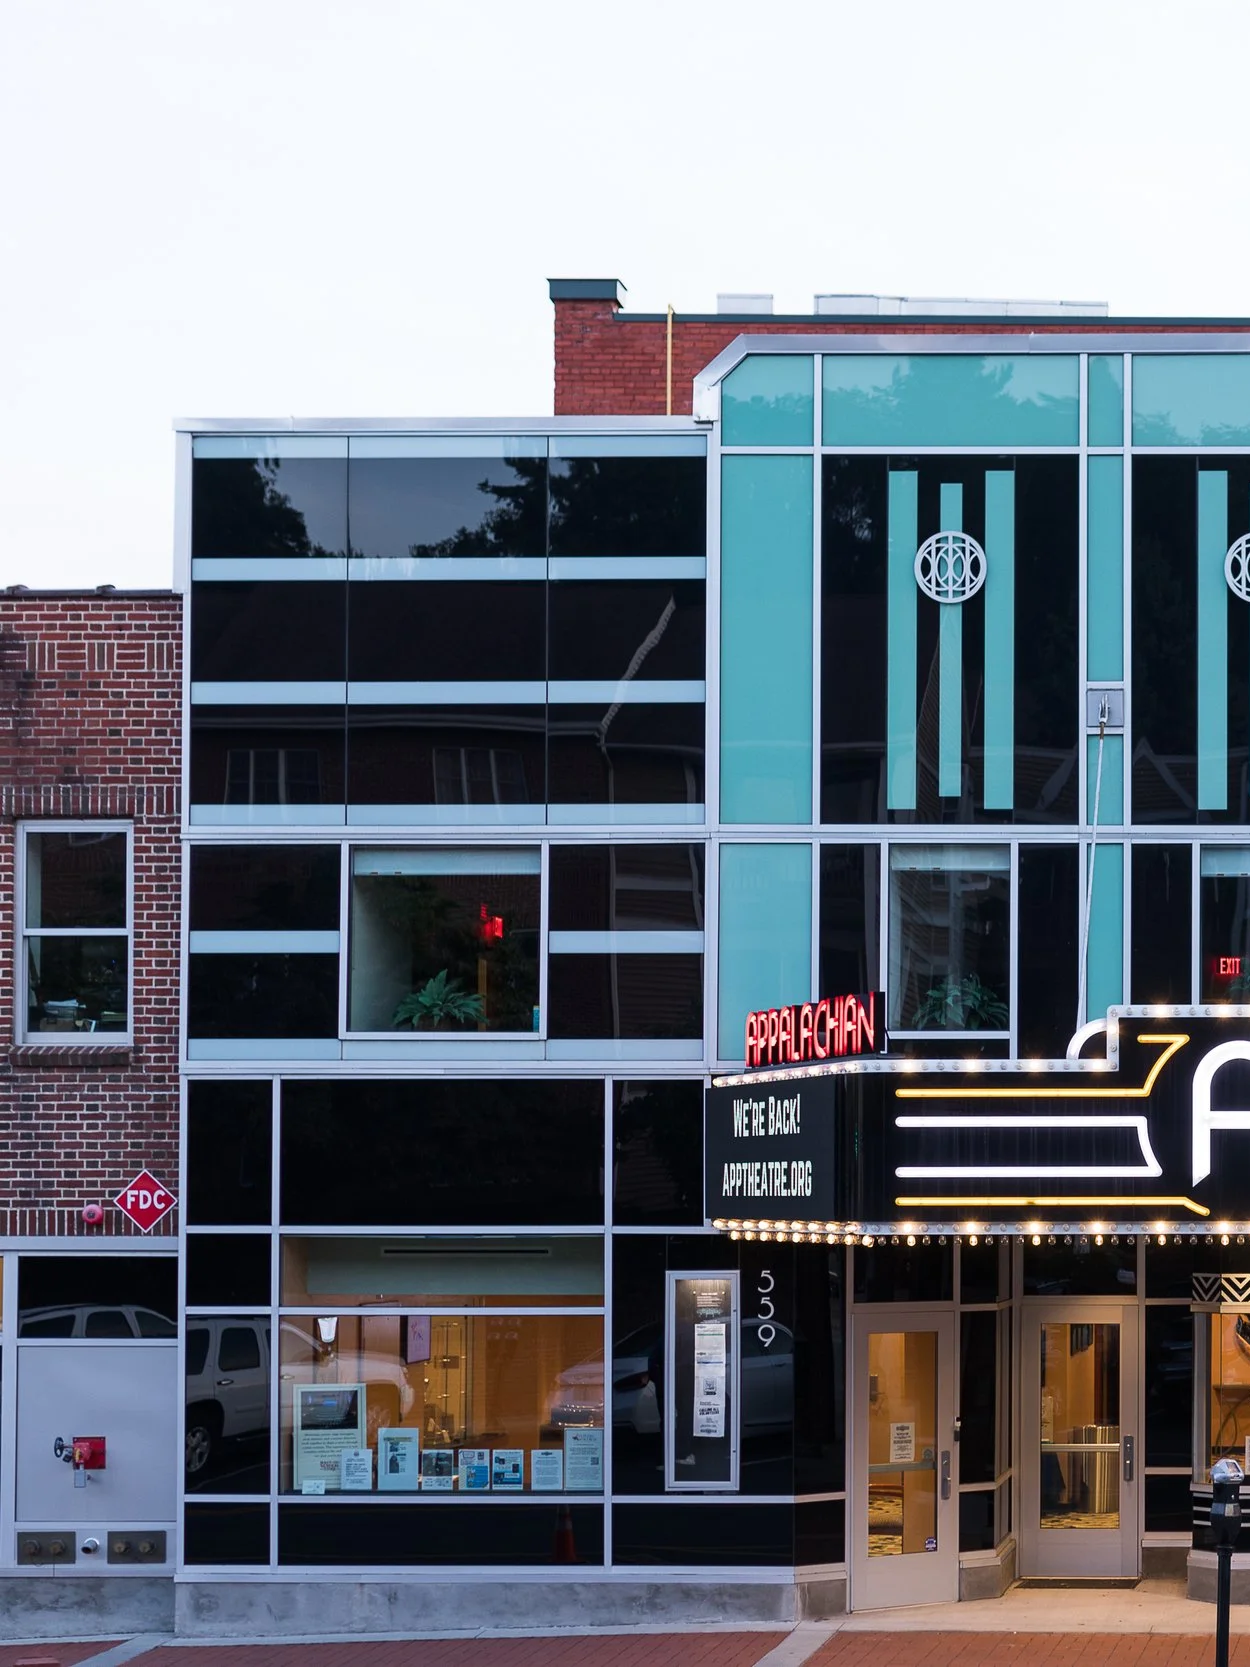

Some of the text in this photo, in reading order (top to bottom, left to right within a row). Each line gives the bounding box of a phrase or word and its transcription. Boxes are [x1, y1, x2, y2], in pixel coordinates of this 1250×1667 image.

[1219, 957, 1241, 975] EXIT
[745, 991, 875, 1067] APPALACHIAN
[722, 1160, 813, 1197] APPTHEATRE.ORG
[127, 1189, 166, 1210] FDC
[757, 1270, 776, 1348] 559
